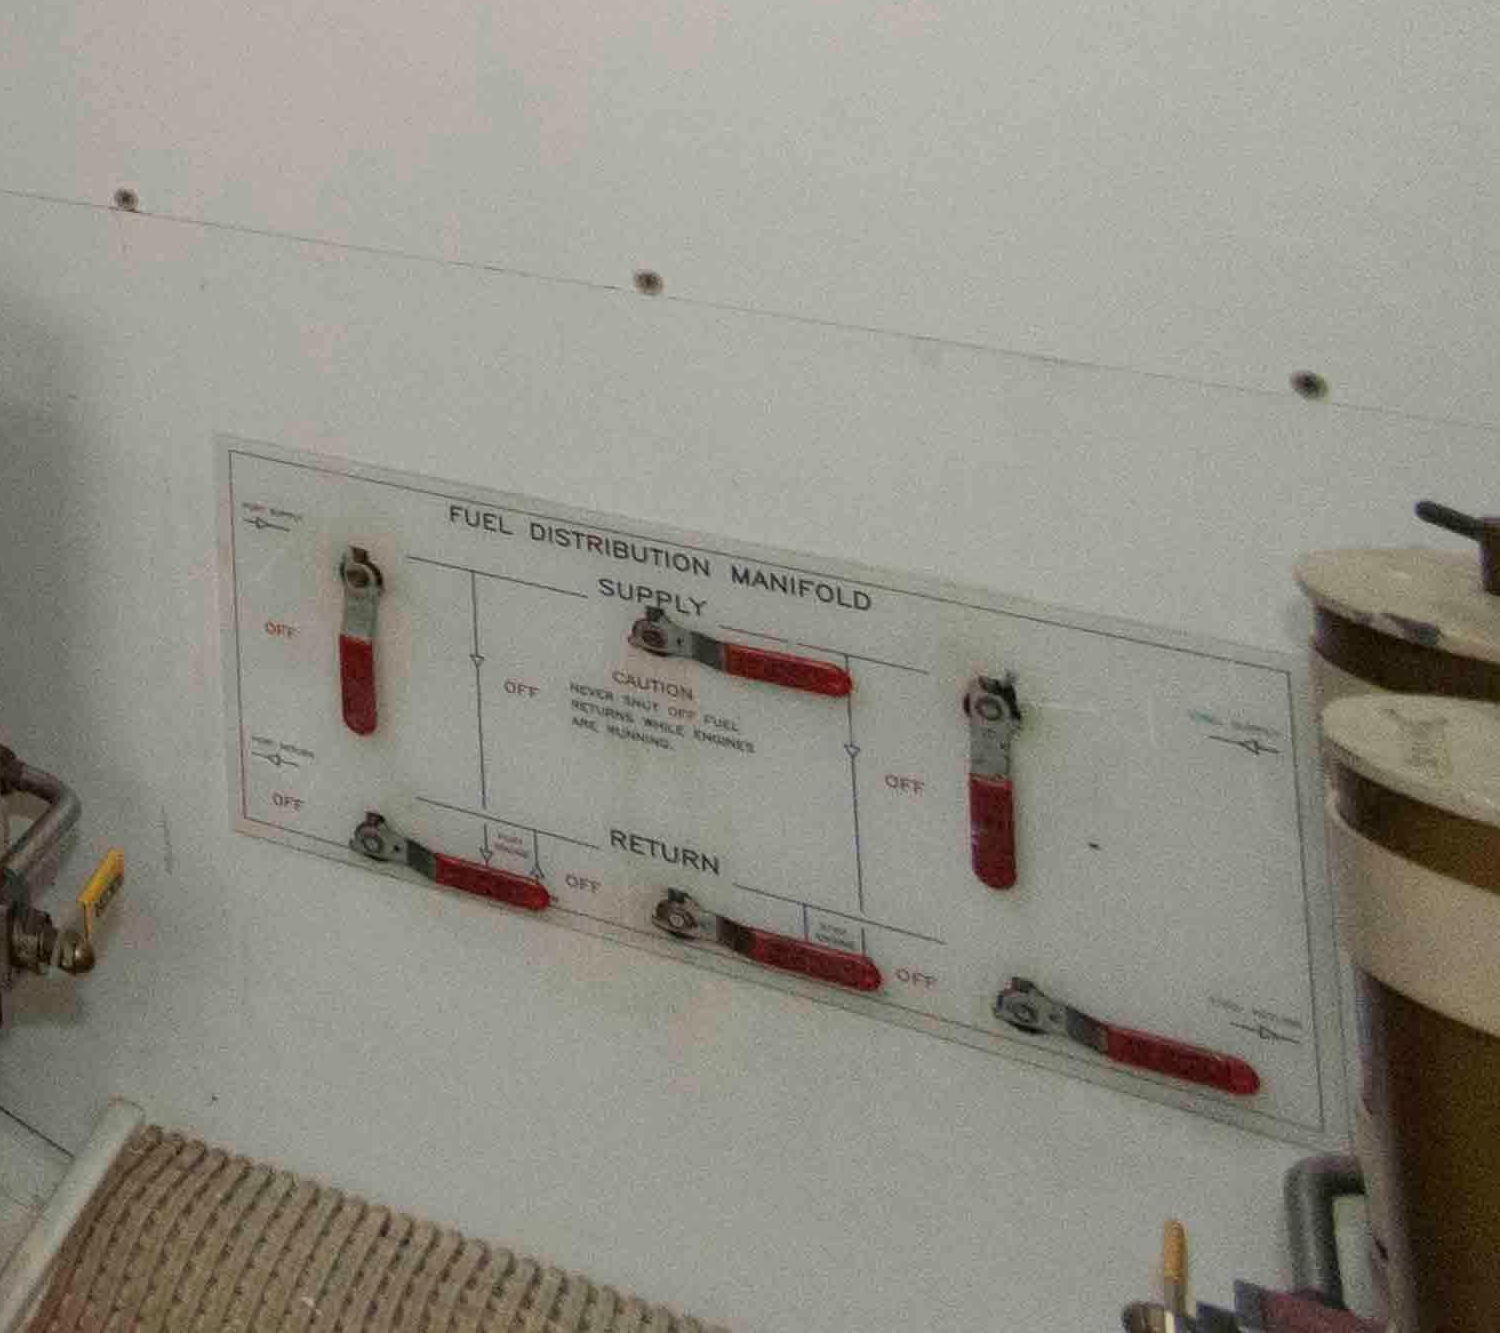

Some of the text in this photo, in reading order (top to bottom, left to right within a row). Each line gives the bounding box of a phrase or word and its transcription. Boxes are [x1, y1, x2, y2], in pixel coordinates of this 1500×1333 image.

[450, 505, 872, 612] FUEL DISTRIBUTION MANIFOLD
[598, 578, 708, 617] SUPPLY
[264, 620, 298, 638] OFF
[504, 680, 540, 699] OFF
[611, 670, 693, 701] CAUTION
[569, 682, 739, 733] NEVER SHUT OFF FUEL
[571, 716, 600, 734] ARE
[571, 699, 755, 754] RETURNS WHILE ENGINES
[885, 773, 926, 795] OFF
[271, 792, 304, 811] OFF
[609, 829, 720, 876] RETURN
[565, 874, 601, 894] OFF
[896, 967, 936, 988] OFF
